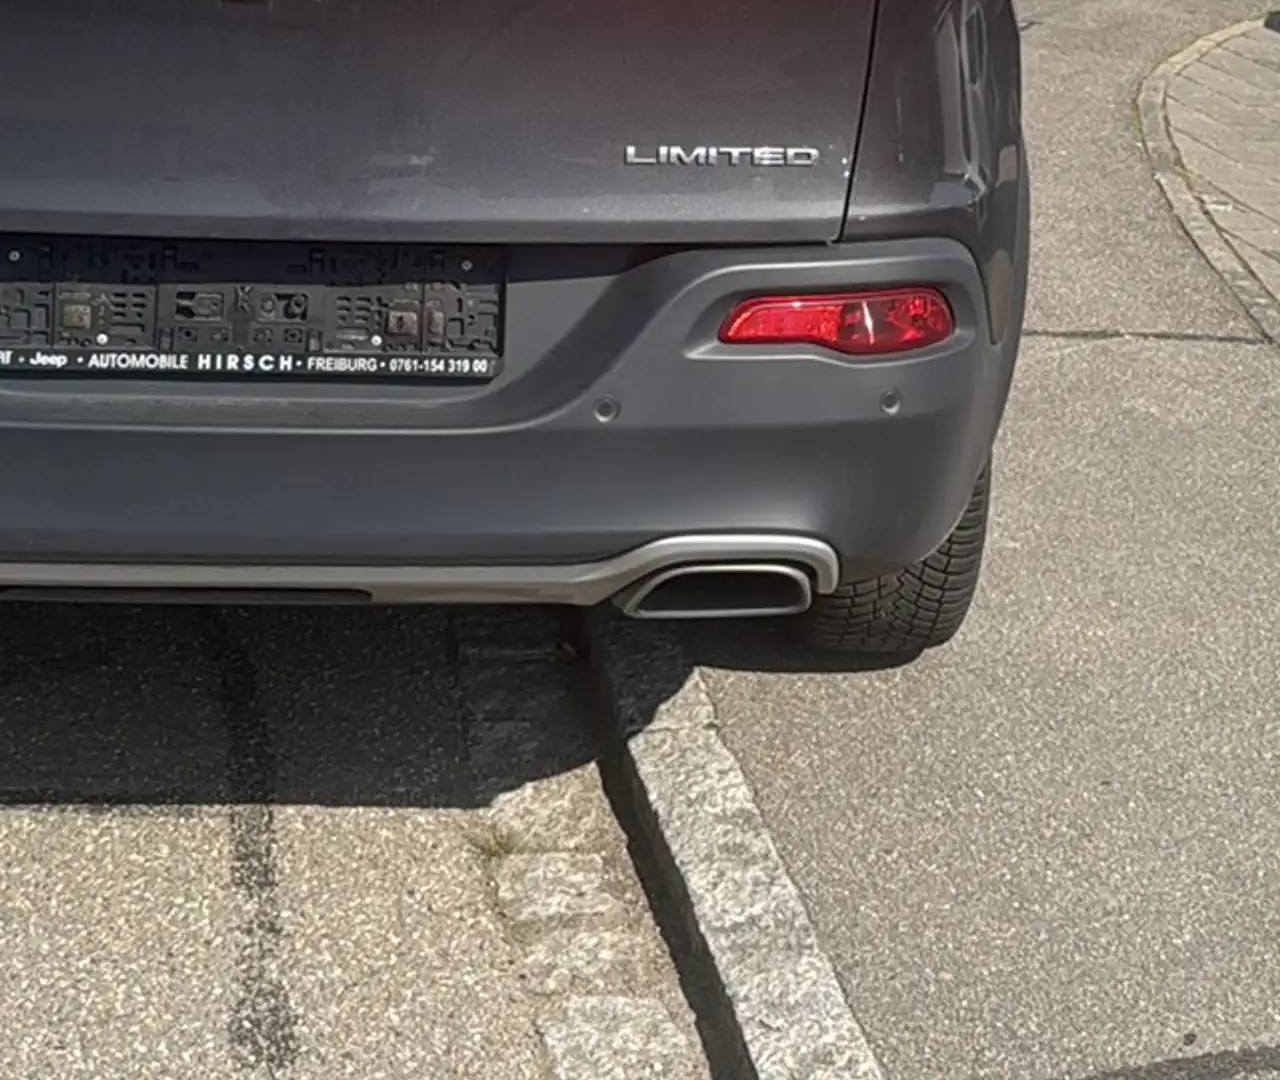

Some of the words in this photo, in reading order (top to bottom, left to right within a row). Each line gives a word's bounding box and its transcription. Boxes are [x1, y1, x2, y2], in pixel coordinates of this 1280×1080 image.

[625, 145, 819, 166] LIMITED
[29, 351, 68, 368] Jeep
[88, 353, 189, 370] AUTOMOBILE
[197, 354, 293, 371] HIRSCH
[307, 357, 378, 372] FREIBURG
